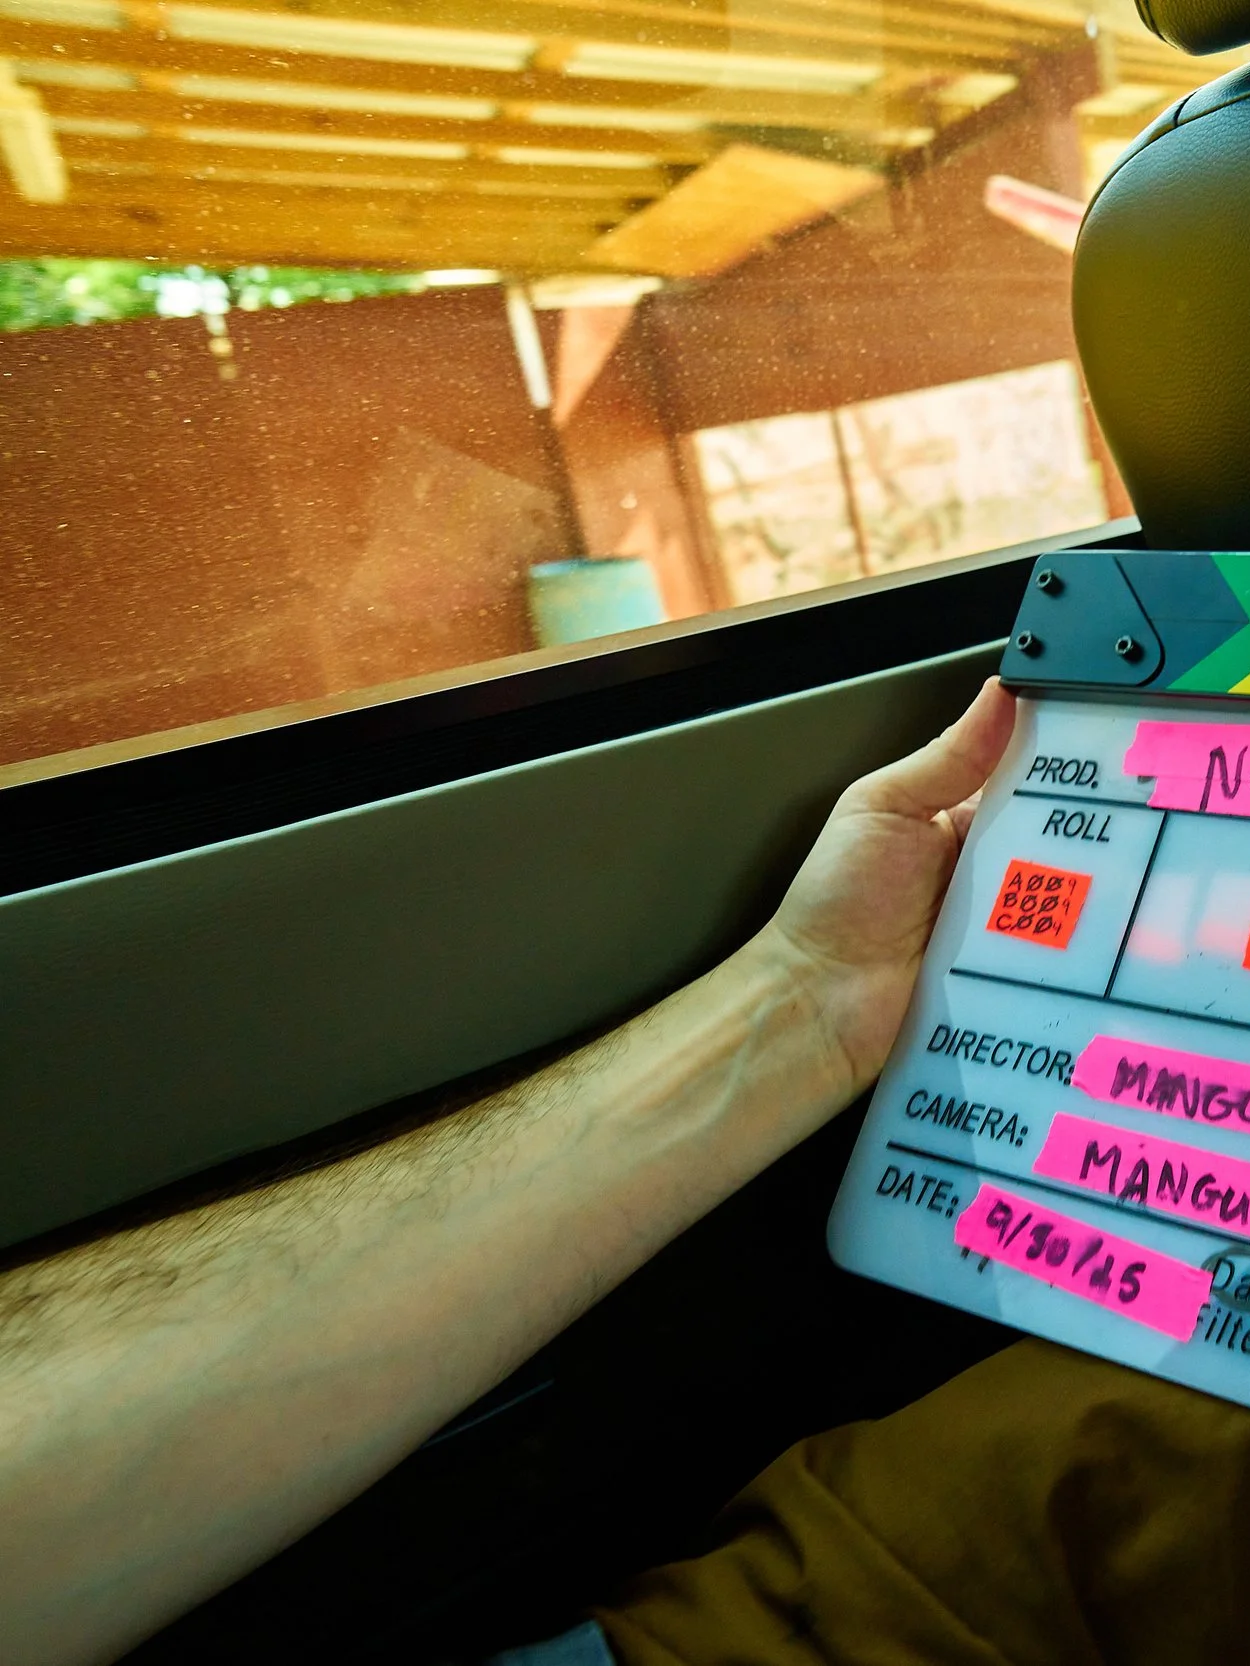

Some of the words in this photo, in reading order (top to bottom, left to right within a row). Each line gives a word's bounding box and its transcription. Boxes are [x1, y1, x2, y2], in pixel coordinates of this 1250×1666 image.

[1026, 755, 1100, 789] PROD.
[1042, 809, 1112, 843] ROLL
[927, 1024, 1075, 1086] DIRECTOR:
[905, 1089, 1028, 1147] CAMERA:
[876, 1164, 958, 1218] DATE:
